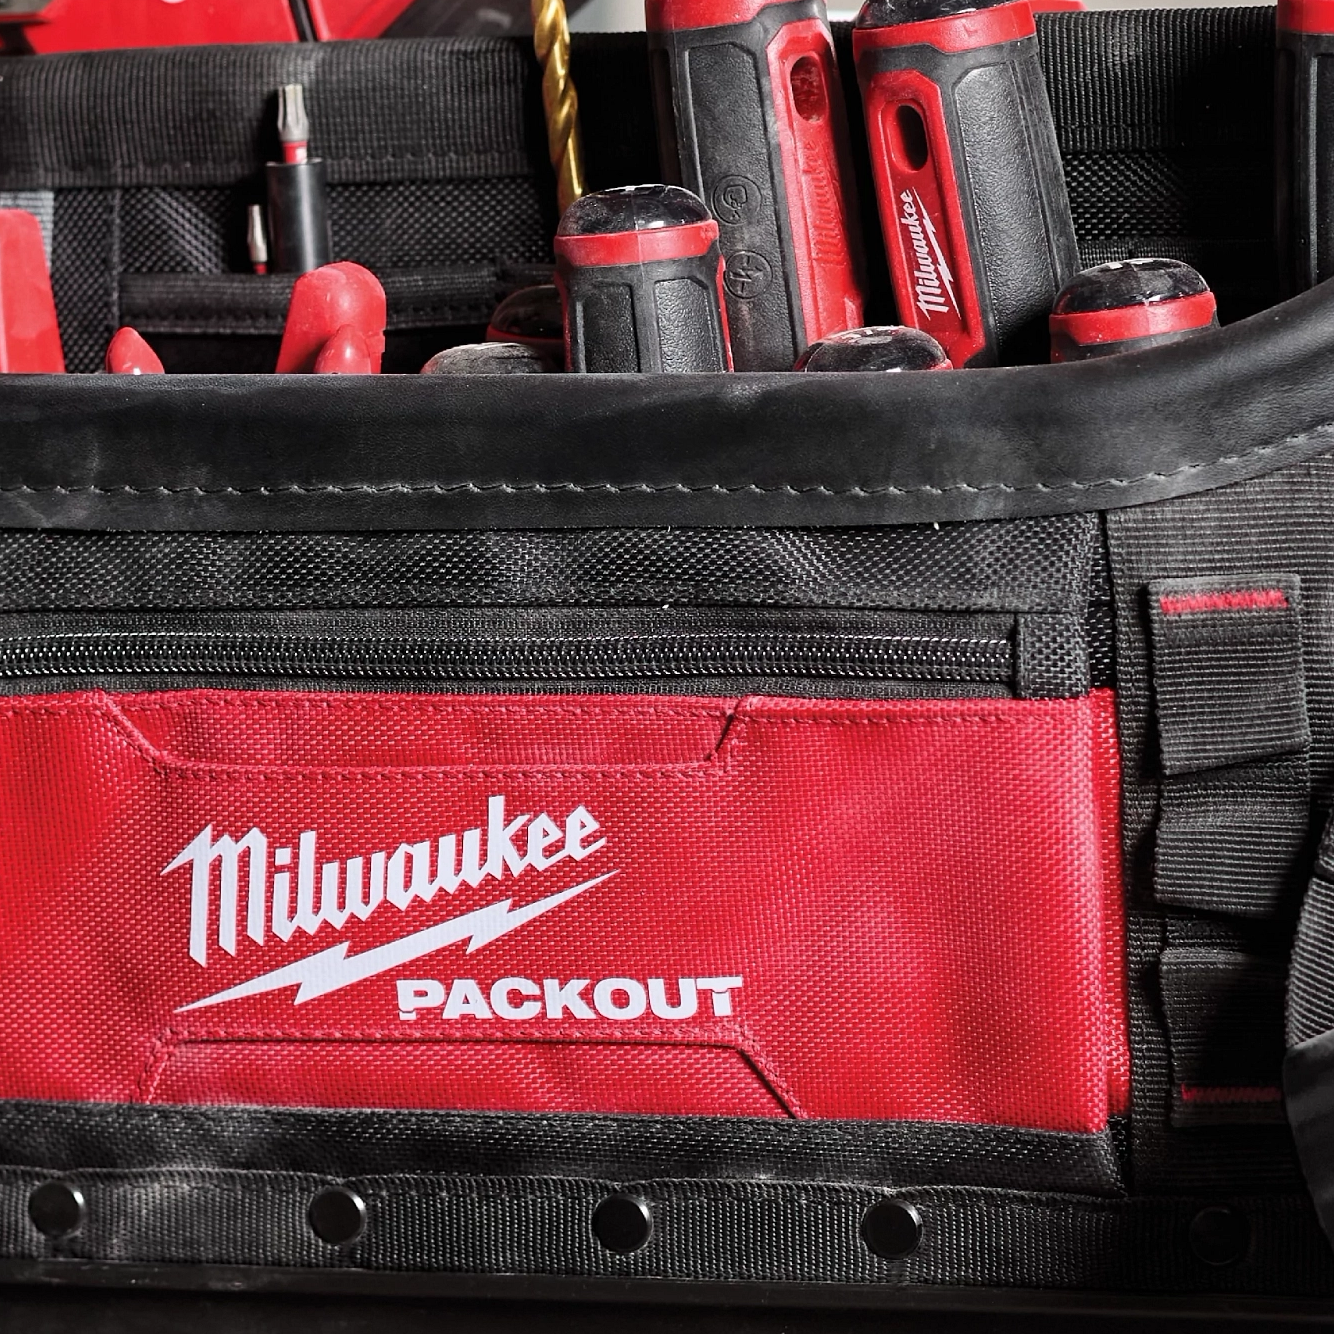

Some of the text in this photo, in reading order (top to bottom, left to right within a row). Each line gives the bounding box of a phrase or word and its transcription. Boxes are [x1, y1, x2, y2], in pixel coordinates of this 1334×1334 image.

[899, 189, 950, 321] Milwaukee
[160, 796, 608, 967] Milwaukee
[396, 974, 743, 1020] PACKOUT
